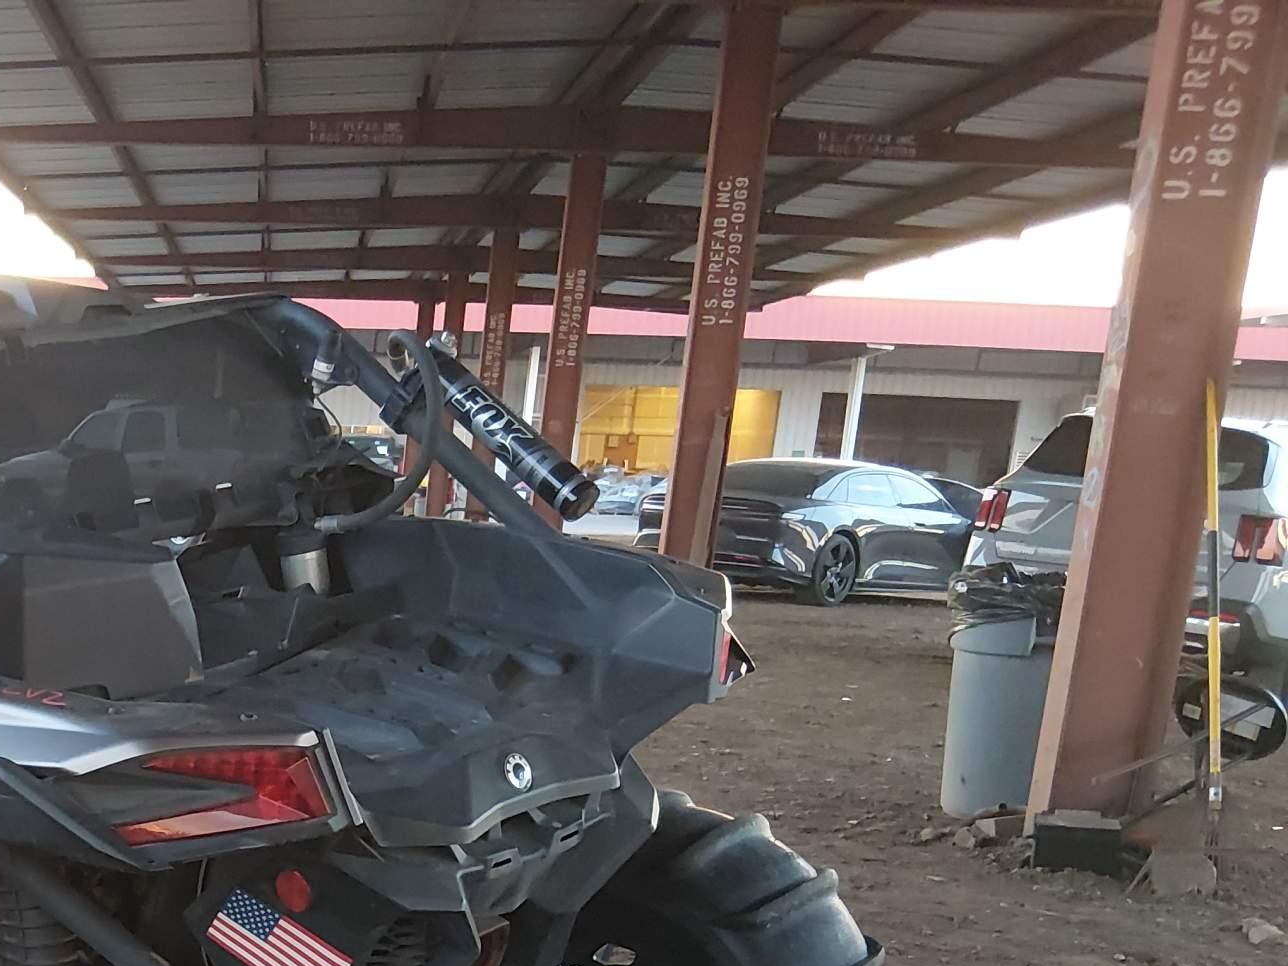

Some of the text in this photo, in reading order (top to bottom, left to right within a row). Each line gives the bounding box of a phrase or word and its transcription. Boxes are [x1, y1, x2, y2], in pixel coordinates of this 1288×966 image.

[715, 176, 733, 208] INC.
[1162, 134, 1200, 200] U.S.
[706, 217, 728, 284] PREFAB
[719, 176, 749, 324] 1-866-799-0969
[451, 386, 535, 461] FOX
